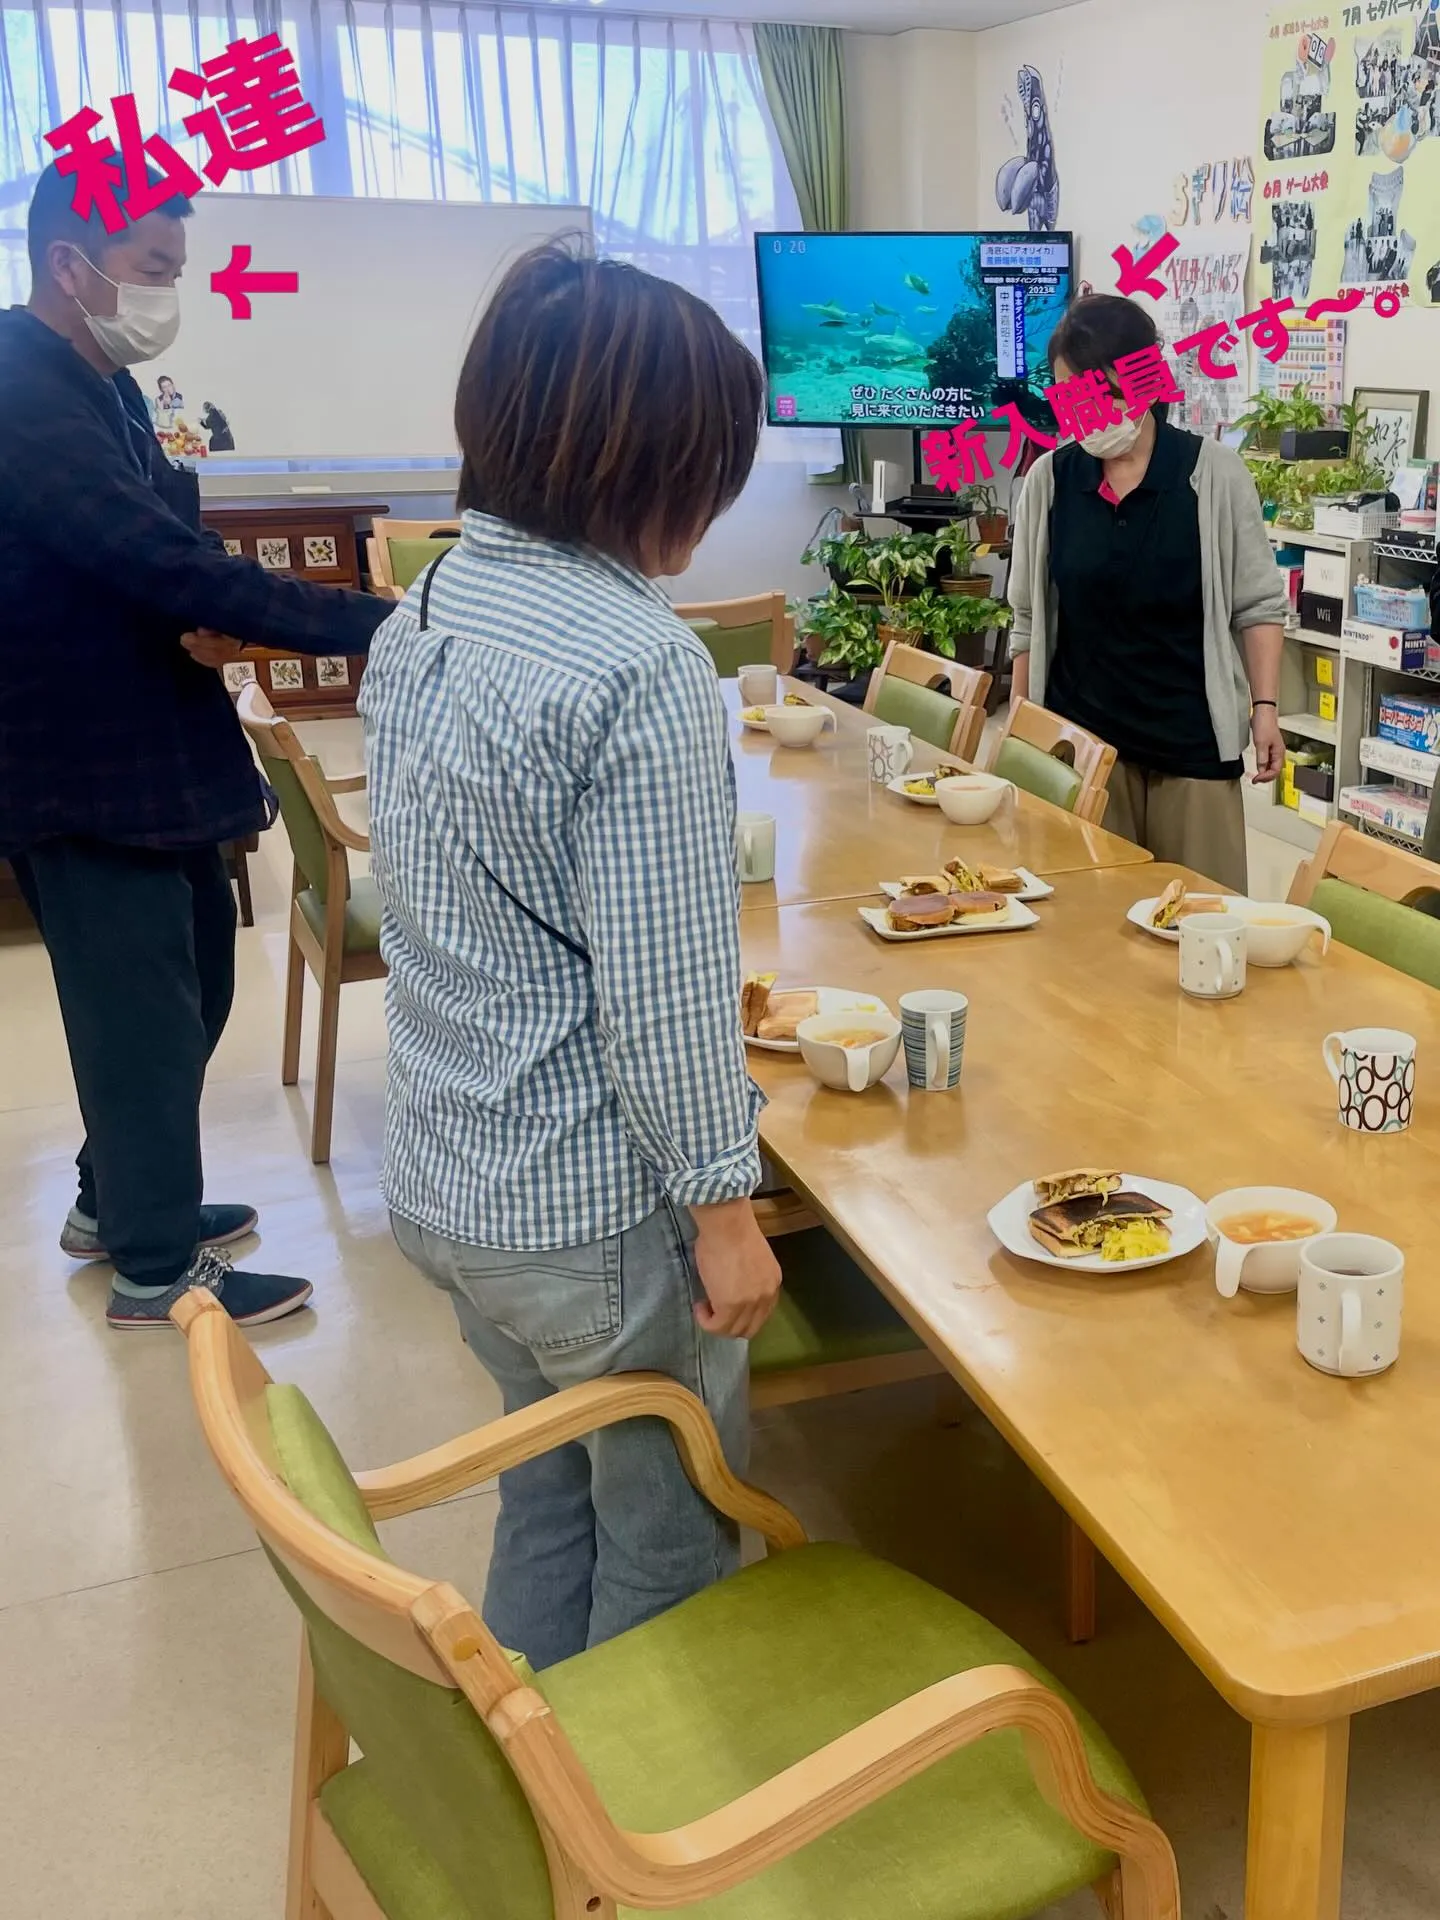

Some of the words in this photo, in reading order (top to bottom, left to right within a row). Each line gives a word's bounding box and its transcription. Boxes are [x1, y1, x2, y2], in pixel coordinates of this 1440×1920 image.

[1342, 5, 1362, 28] 7月
[1263, 181, 1282, 199] 6月
[1286, 170, 1330, 195] ゲーム大会
[1028, 286, 1056, 294] 2023年
[851, 385, 876, 400] ぜひ
[880, 386, 973, 401] たくさんの方に
[851, 403, 985, 419] 見に来ていただきたい
[1316, 607, 1332, 622] Wii
[1343, 629, 1370, 642] NINTENDO
